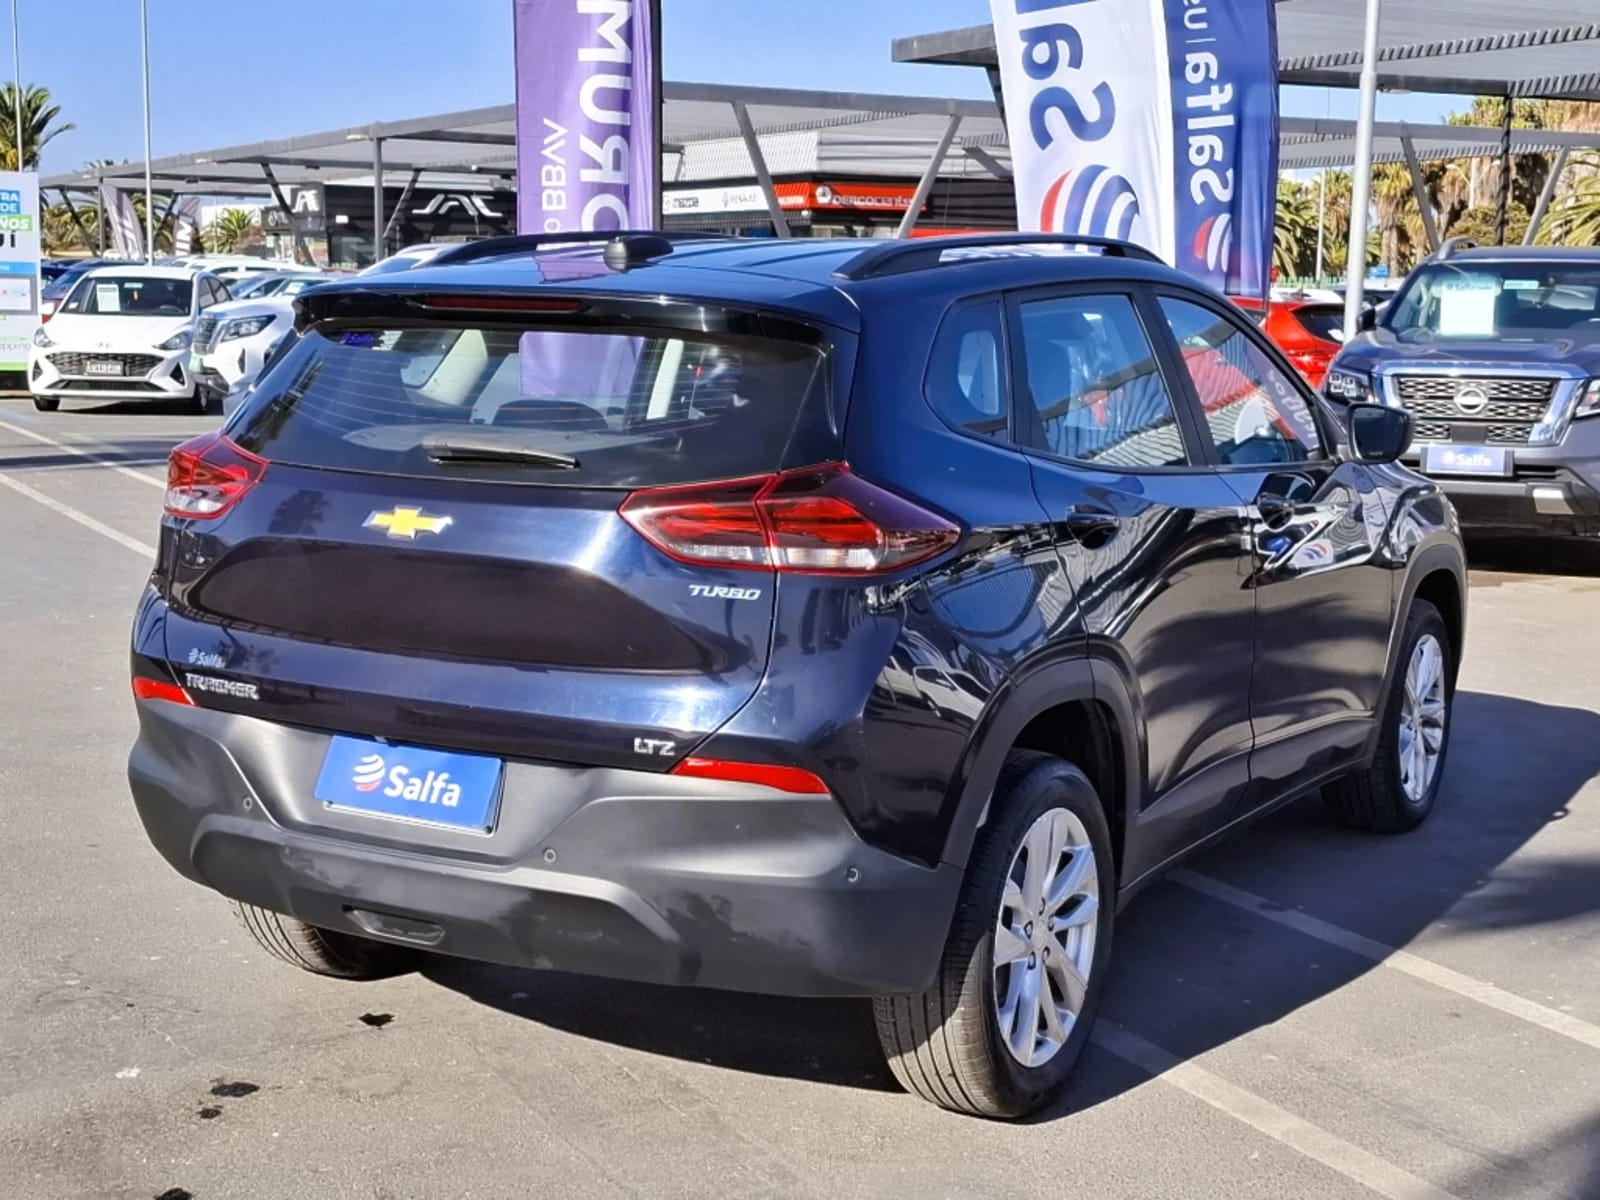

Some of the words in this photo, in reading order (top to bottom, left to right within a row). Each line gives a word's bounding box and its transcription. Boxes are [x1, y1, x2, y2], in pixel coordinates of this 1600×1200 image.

[0, 192, 19, 202] RA
[1456, 453, 1491, 466] Salfa
[688, 584, 762, 601] TURBO
[185, 672, 260, 701] TRACKER
[633, 737, 676, 757] LTZ
[383, 764, 461, 808] Salfa
